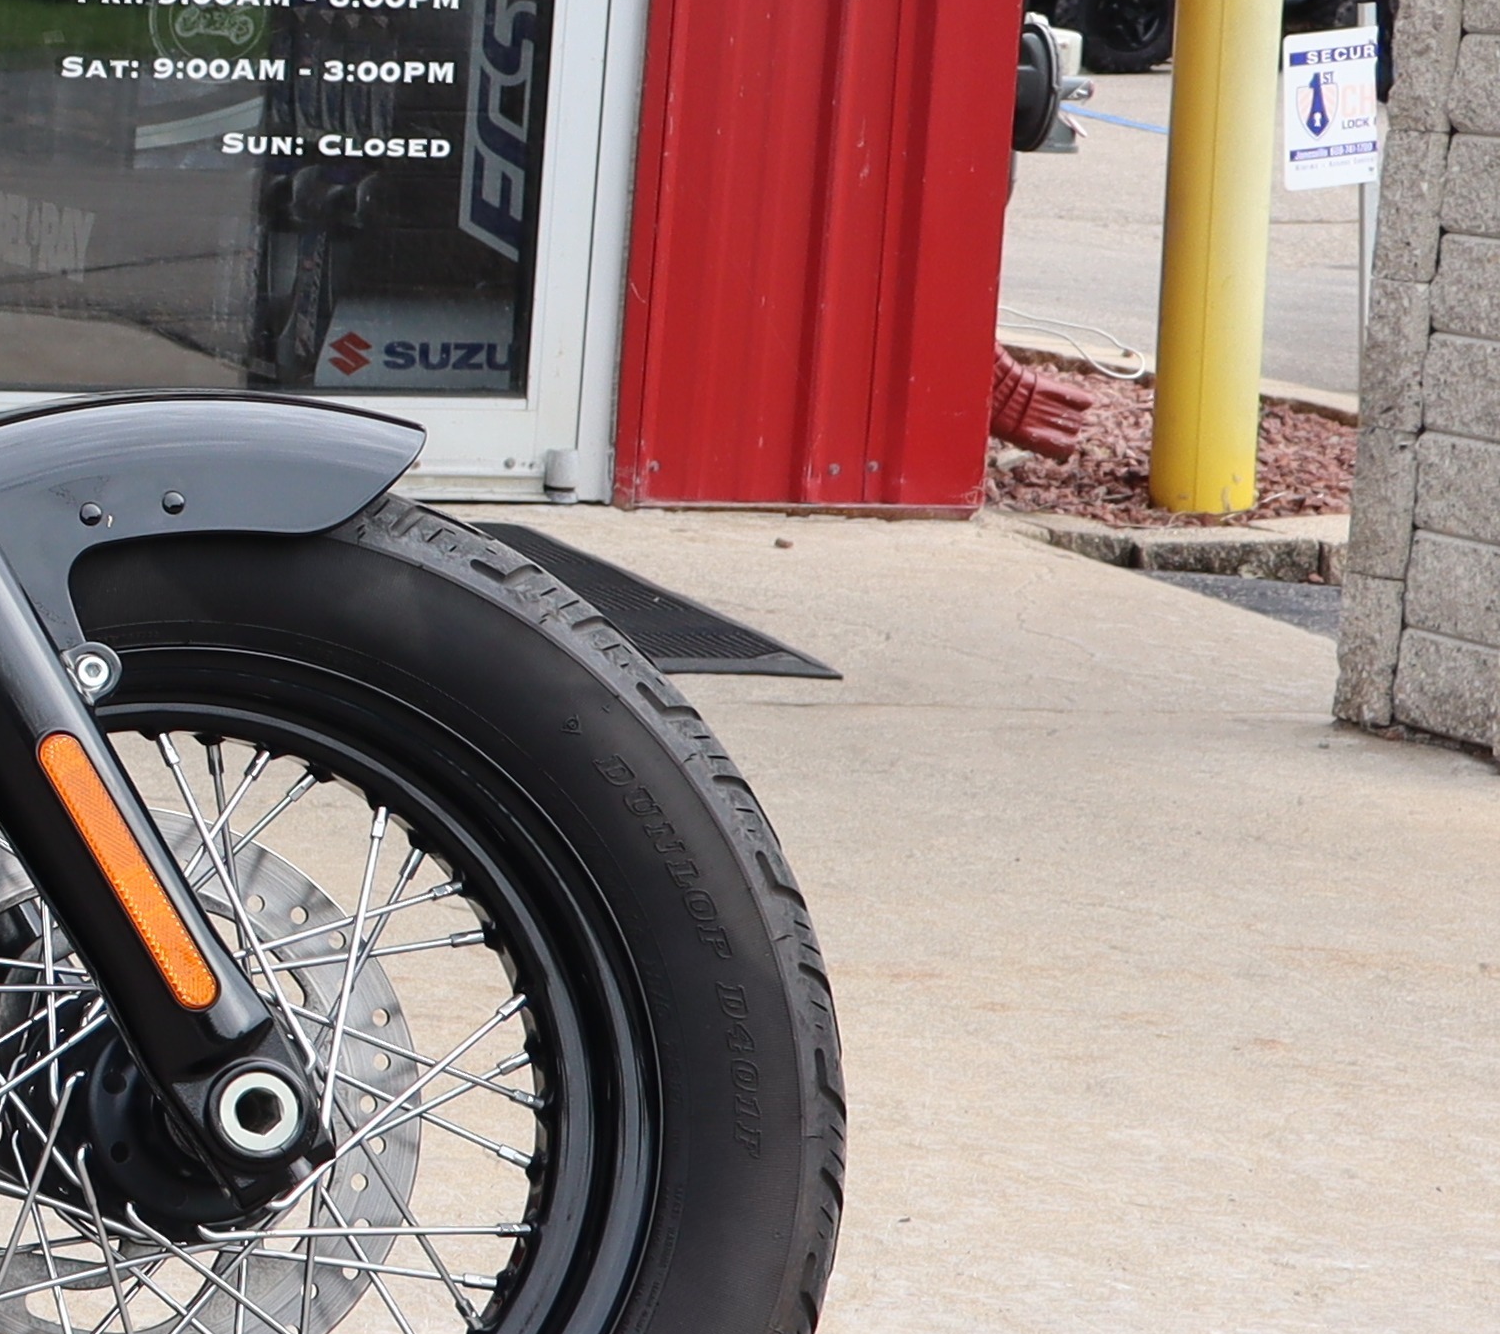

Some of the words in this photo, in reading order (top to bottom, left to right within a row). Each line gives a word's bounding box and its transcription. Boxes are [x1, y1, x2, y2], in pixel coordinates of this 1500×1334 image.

[62, 57, 138, 78] SAT:
[154, 58, 285, 80] 9:00AM
[324, 61, 454, 83] 3:00PM
[1342, 118, 1369, 129] LOCK
[222, 133, 303, 155] SUN:
[319, 135, 450, 157] CLOSED
[592, 753, 733, 960] DUNLOP
[715, 980, 763, 1160] D401F
